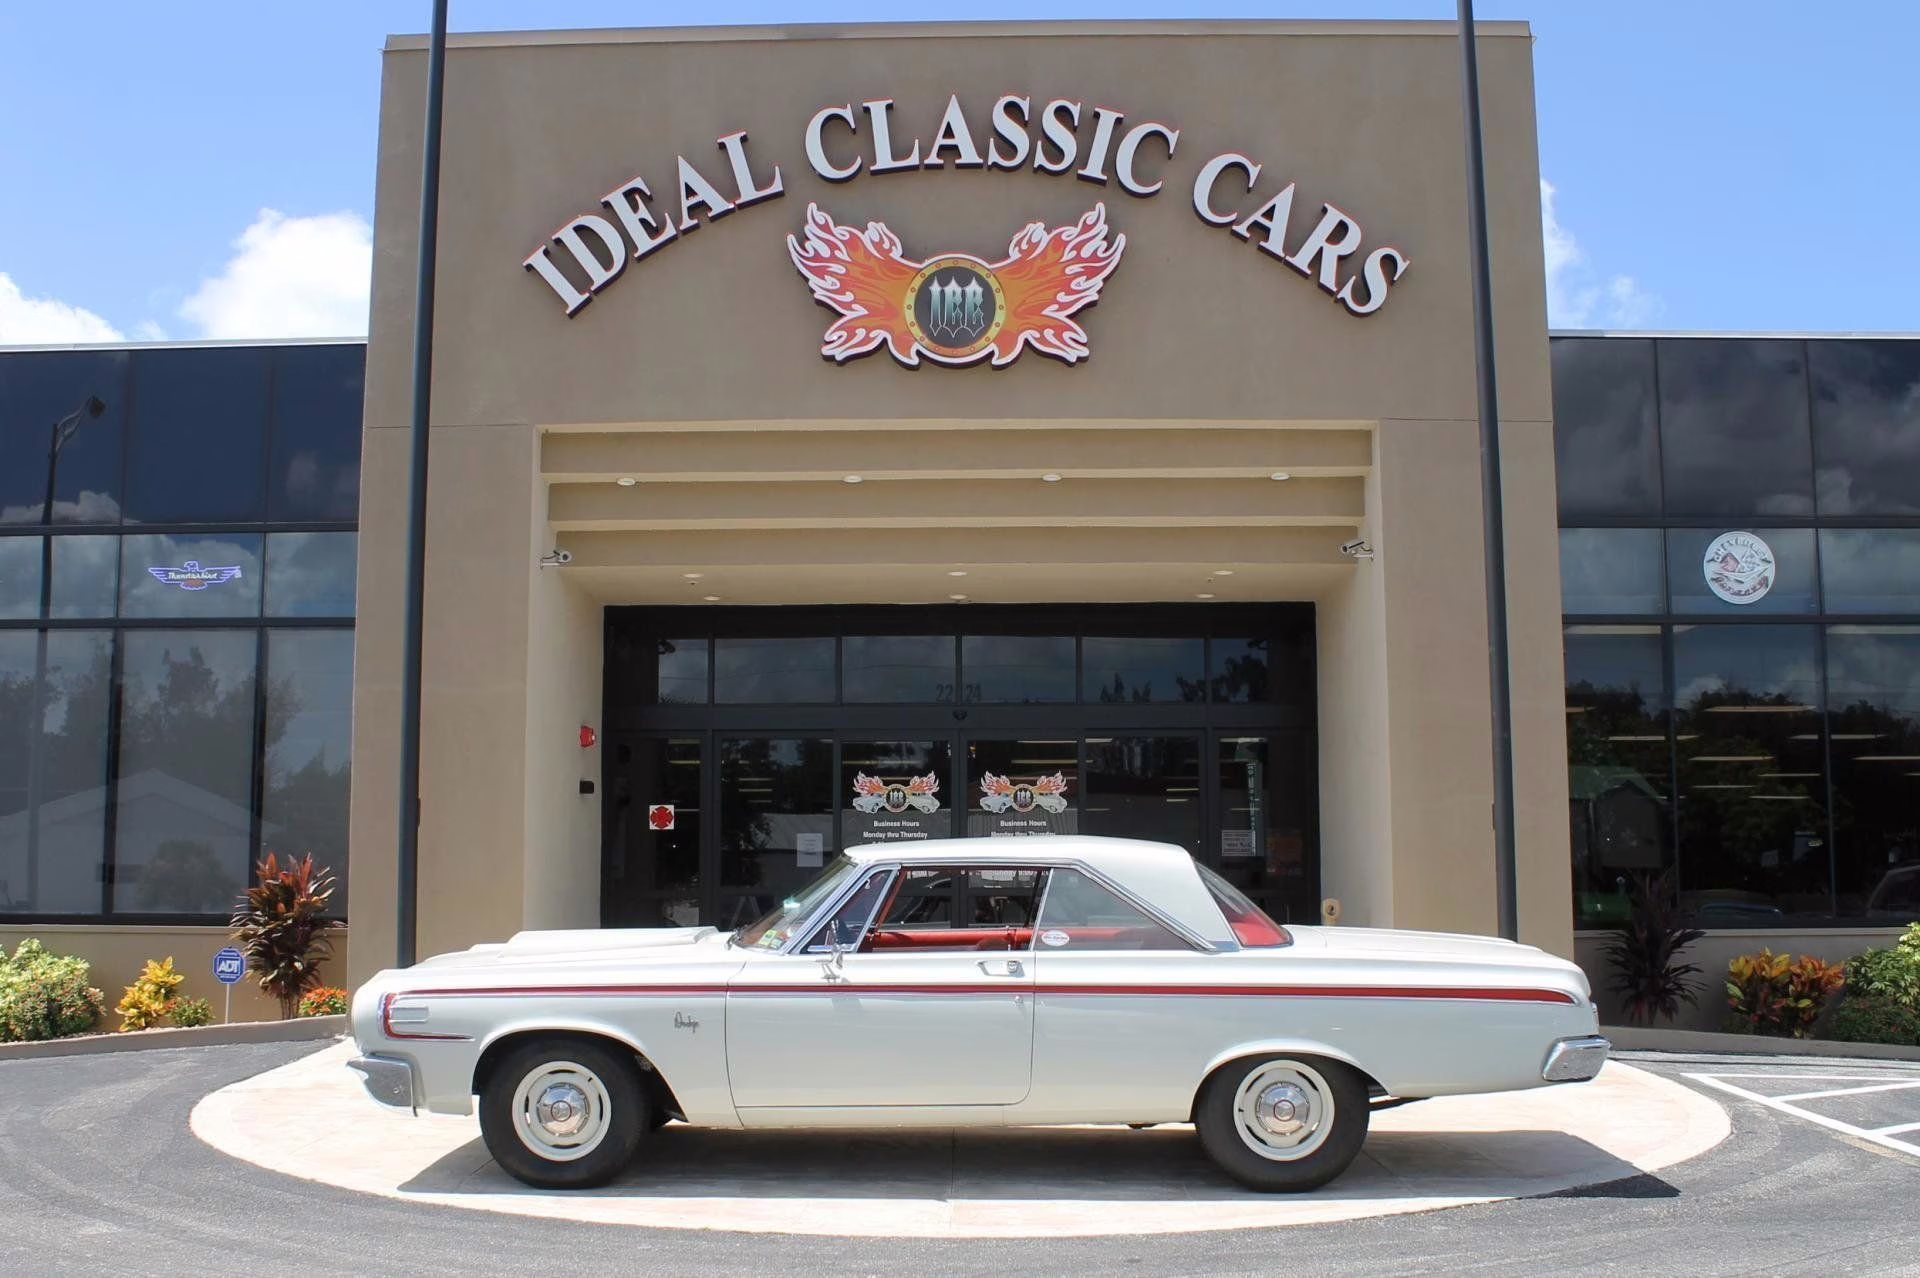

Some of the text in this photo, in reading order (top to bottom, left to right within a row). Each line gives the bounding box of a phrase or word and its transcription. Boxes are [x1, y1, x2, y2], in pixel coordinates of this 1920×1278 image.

[522, 94, 1411, 318] IDEAL CLASSIC CARS
[863, 831, 886, 839] Monday
[900, 831, 928, 839] Thursday
[218, 960, 239, 973] ADT
